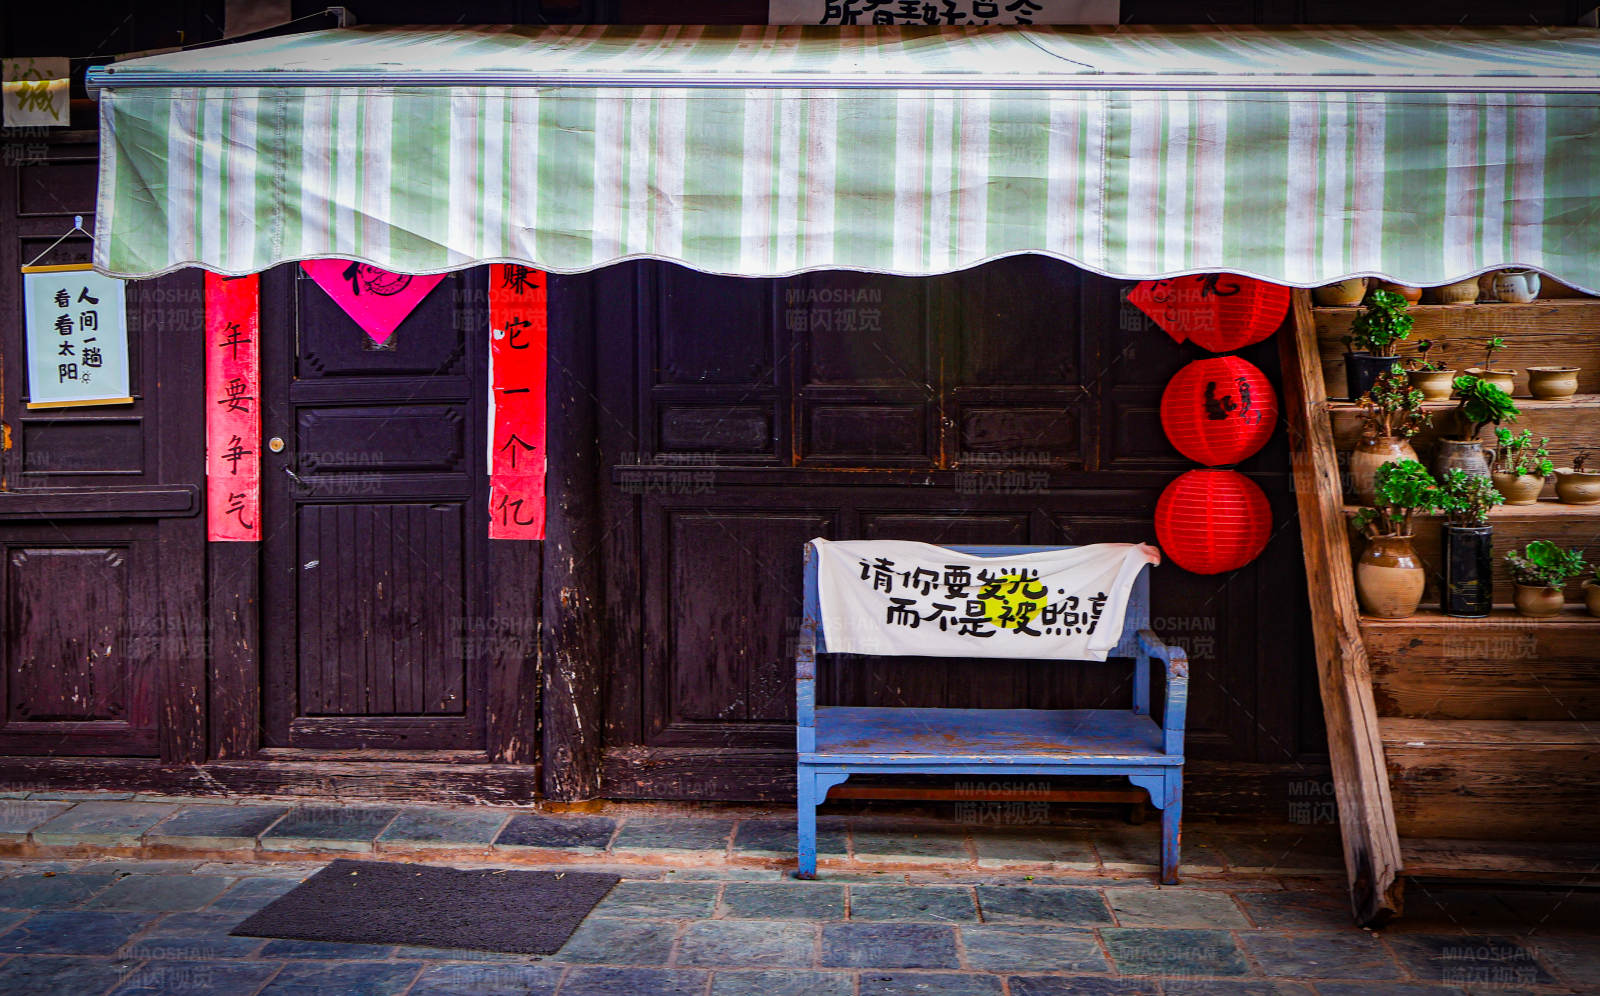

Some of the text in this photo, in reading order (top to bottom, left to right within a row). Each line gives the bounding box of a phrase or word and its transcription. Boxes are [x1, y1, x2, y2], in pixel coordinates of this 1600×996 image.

[54, 288, 78, 383] 看看太阳
[77, 286, 103, 368] 人间一趟
[498, 263, 540, 526] 赚它一个亿
